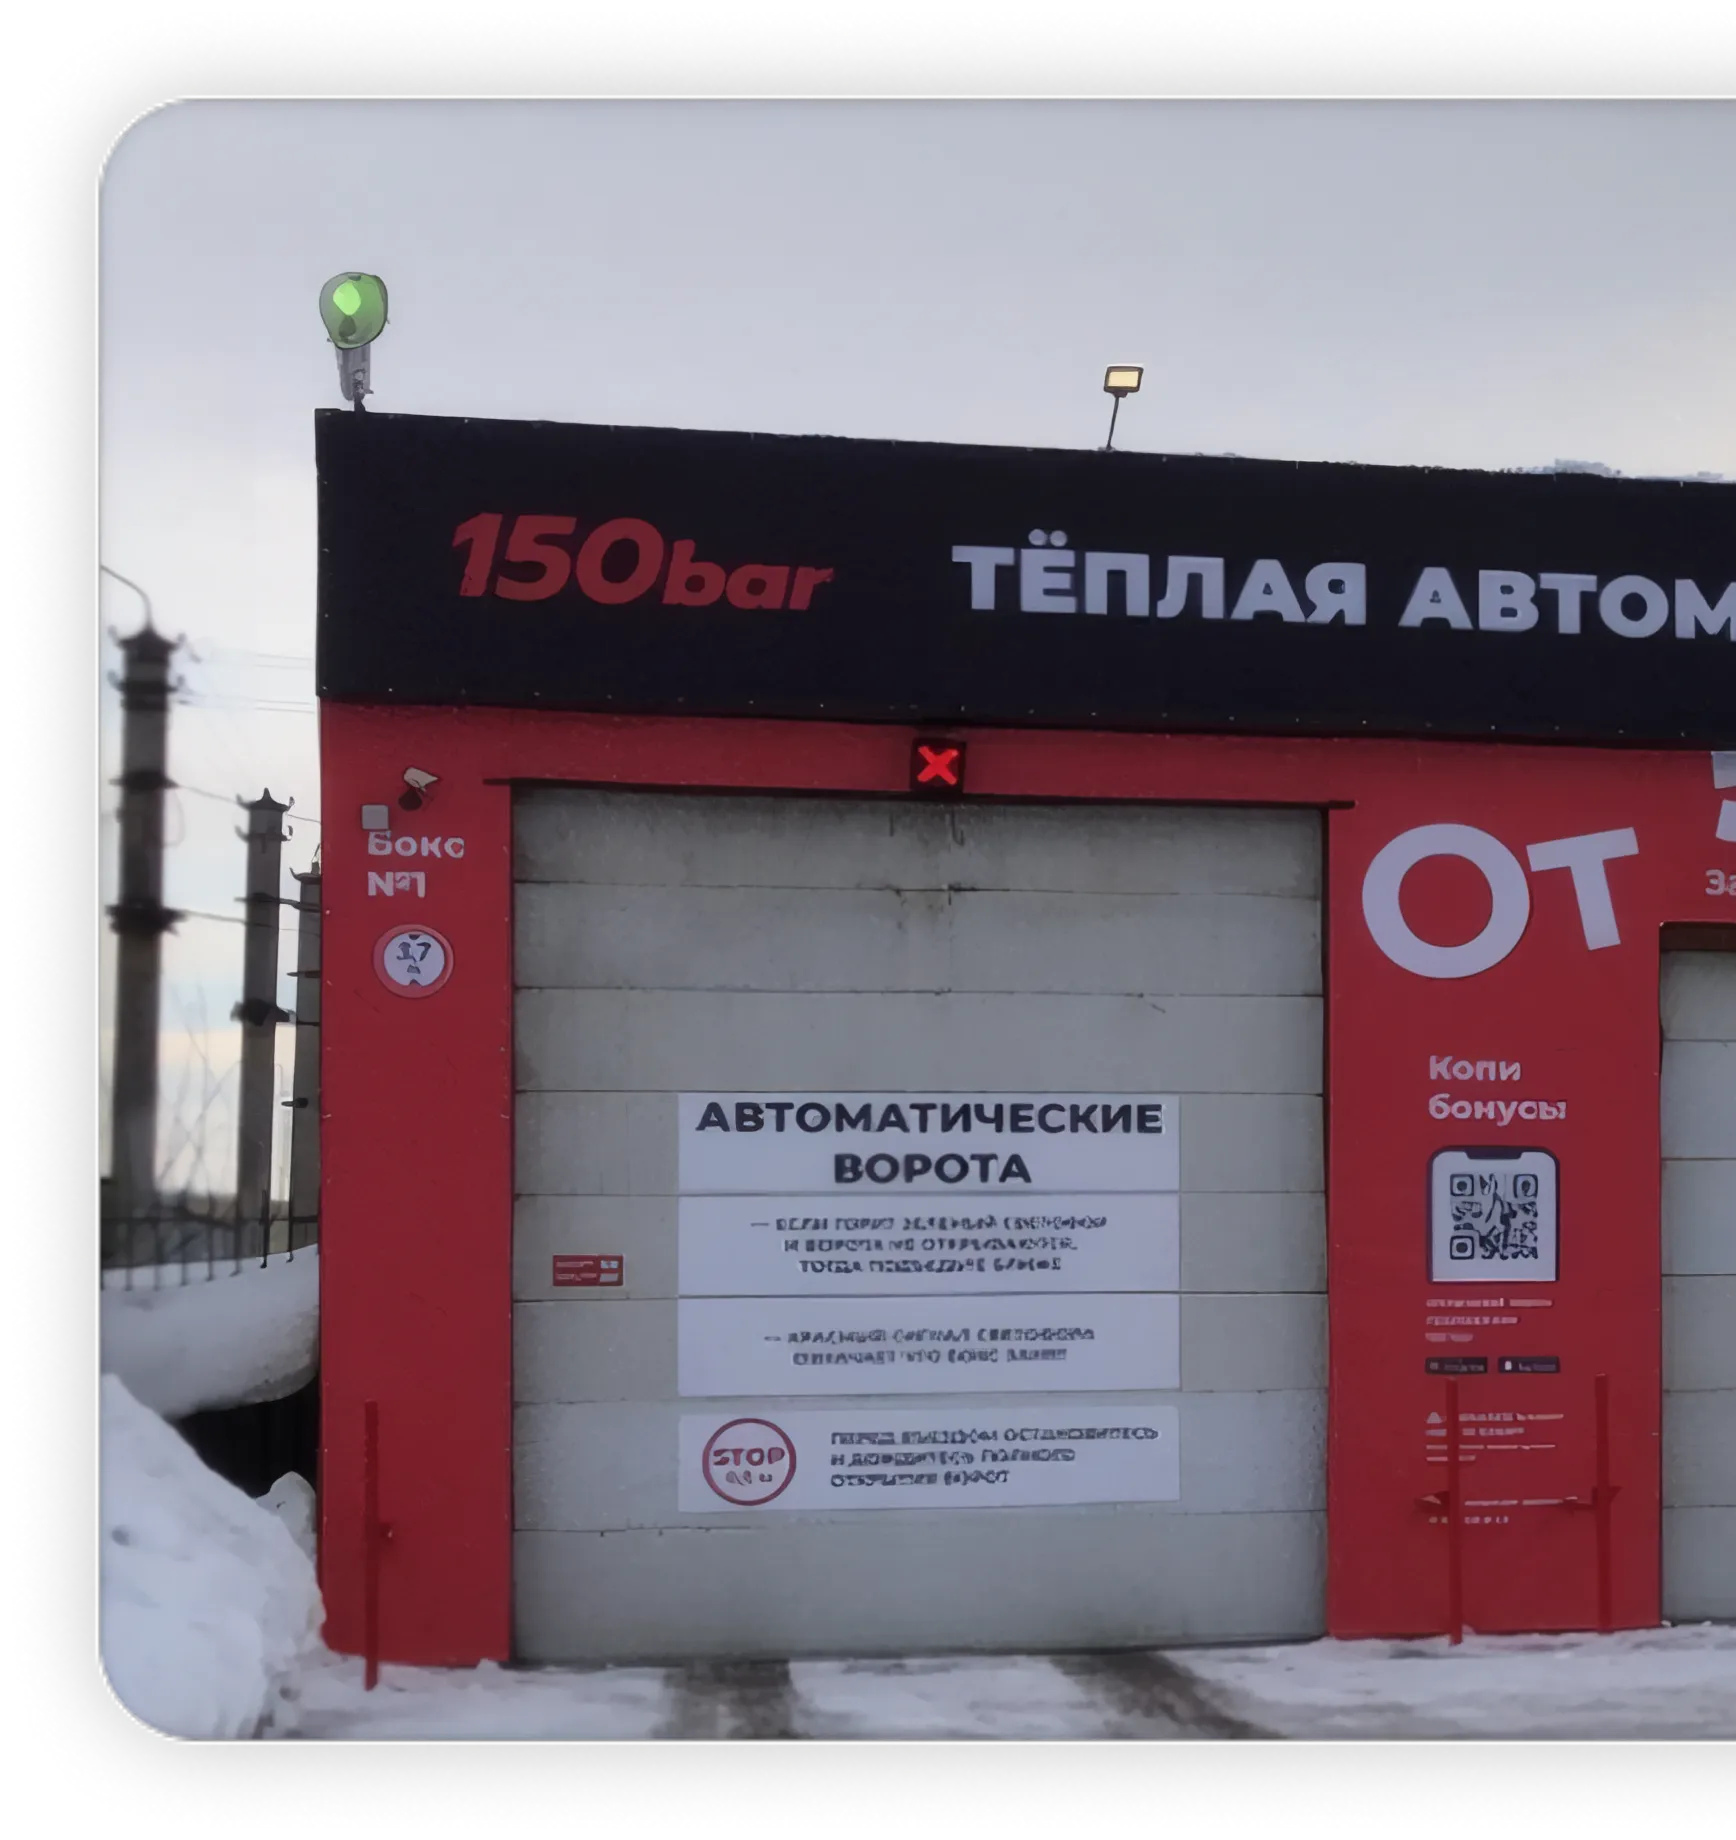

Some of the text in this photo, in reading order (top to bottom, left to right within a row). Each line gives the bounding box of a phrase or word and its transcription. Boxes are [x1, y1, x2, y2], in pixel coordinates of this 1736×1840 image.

[453, 512, 834, 610] 150bar
[951, 528, 1367, 626] ТЁПЛАЯ
[368, 830, 465, 858] Бокс
[1361, 822, 1640, 979] ОТ
[1429, 1055, 1521, 1081] Копи
[695, 1101, 1164, 1134] АВТОМАТИЧЕСКИЕ
[1428, 1092, 1567, 1127] бонусы
[834, 1152, 1032, 1185] ВОРОТА
[713, 1447, 785, 1466] STOP
